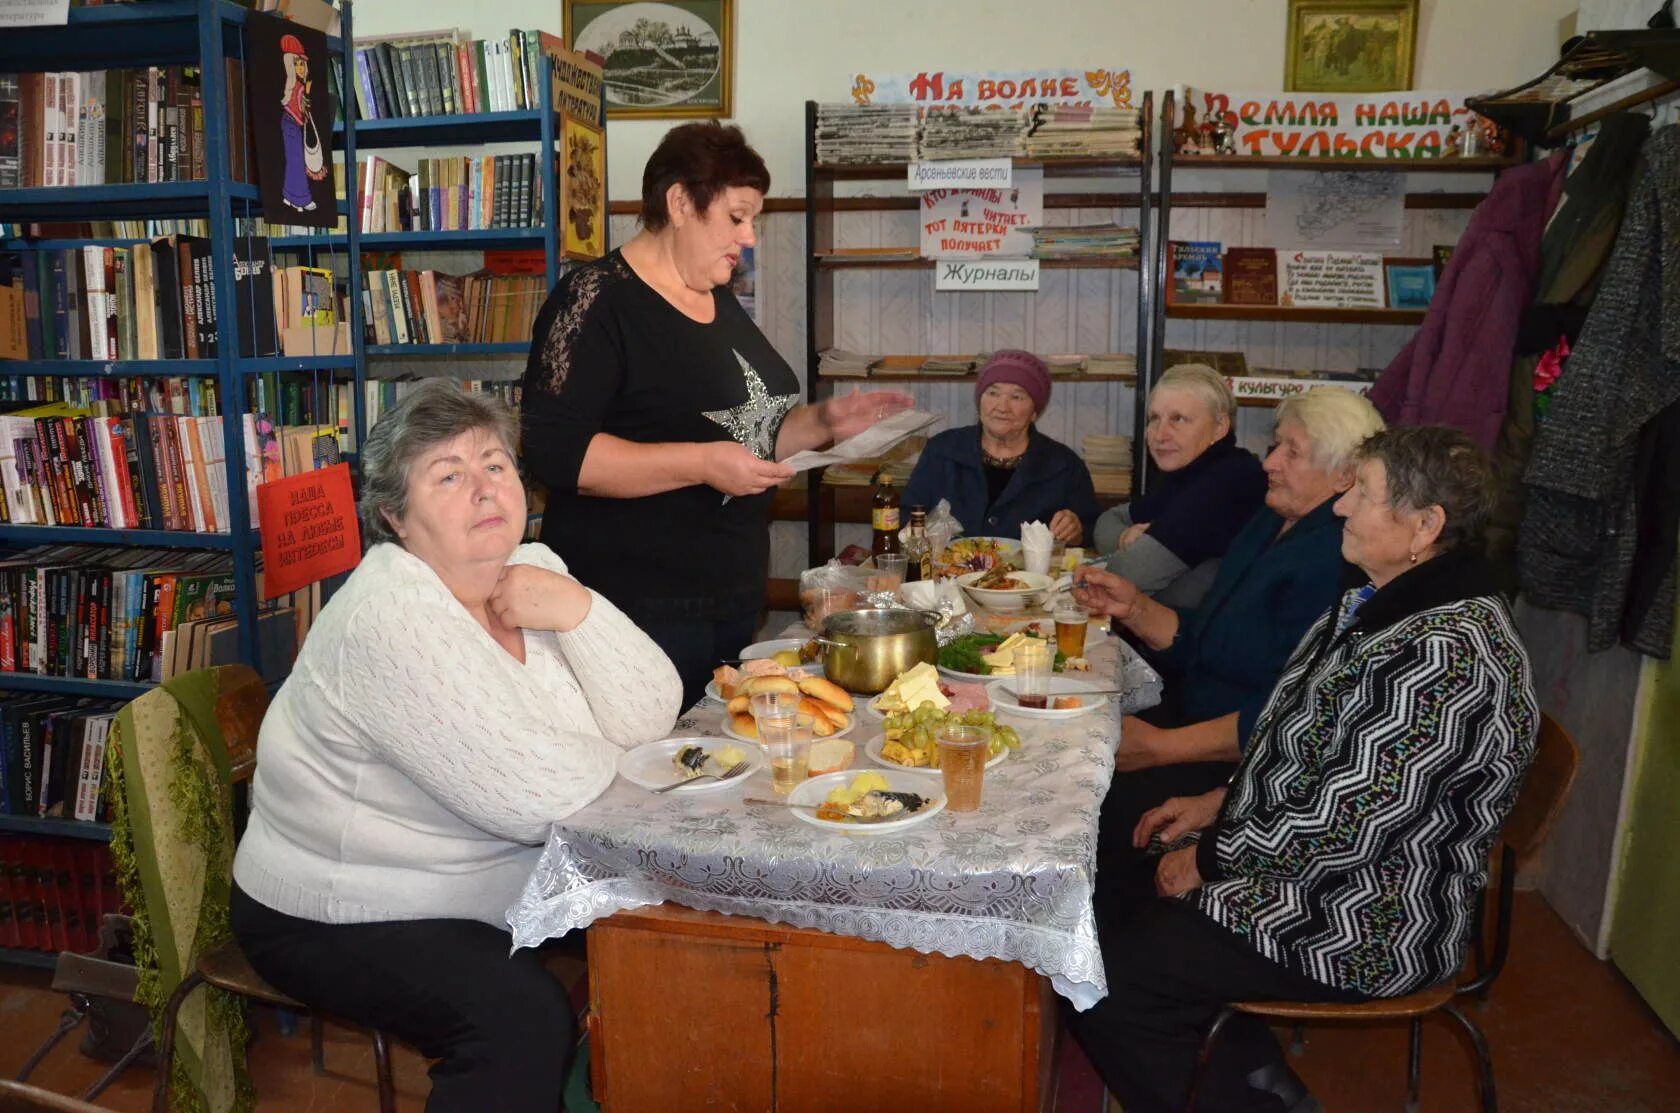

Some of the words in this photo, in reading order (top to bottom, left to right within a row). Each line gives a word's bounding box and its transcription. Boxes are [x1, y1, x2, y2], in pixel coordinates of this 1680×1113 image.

[1242, 129, 1441, 157] ТУЛЬСКА
[914, 164, 977, 184] Арсеньевские
[978, 166, 1009, 181] вести
[923, 188, 948, 208] КТО
[924, 218, 947, 235] ТОТ
[953, 220, 1008, 237] ПЯТЕРКИ
[940, 239, 1002, 253] ПОЛУЧАЕТ
[943, 263, 1036, 284] Журналы
[290, 485, 326, 505] НАША
[277, 530, 297, 548] НА
[25, 771, 33, 802] БОРИС
